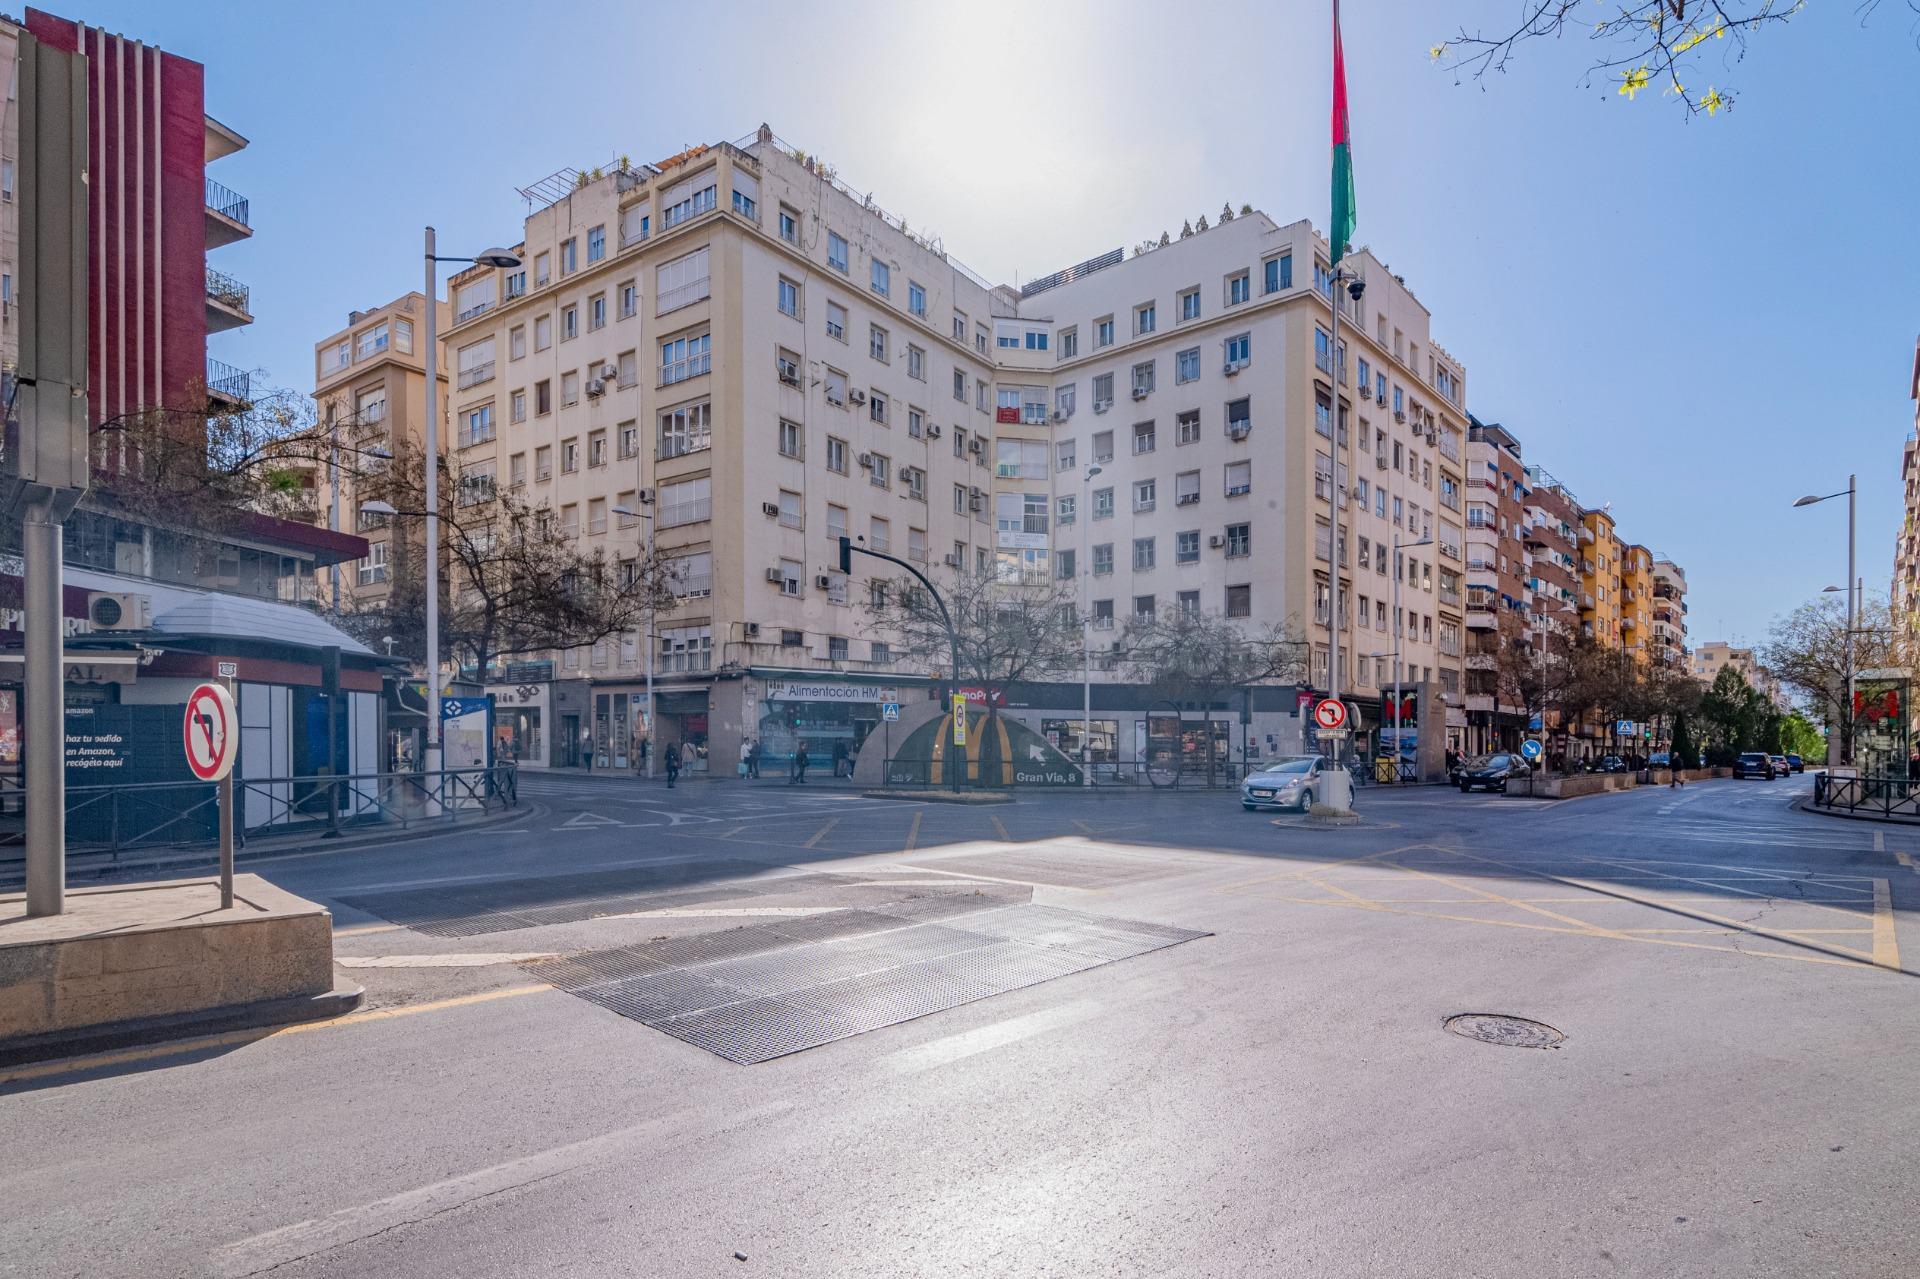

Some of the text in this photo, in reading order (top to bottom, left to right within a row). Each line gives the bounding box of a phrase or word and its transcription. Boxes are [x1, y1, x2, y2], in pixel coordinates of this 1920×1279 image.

[788, 684, 878, 699] Alimentación HM
[65, 734, 81, 743] haz
[83, 735, 92, 743] tu
[65, 747, 116, 756] en Amazon,
[103, 757, 124, 769] aquí
[1016, 772, 1044, 783] Gran
[1068, 773, 1077, 783] 8
